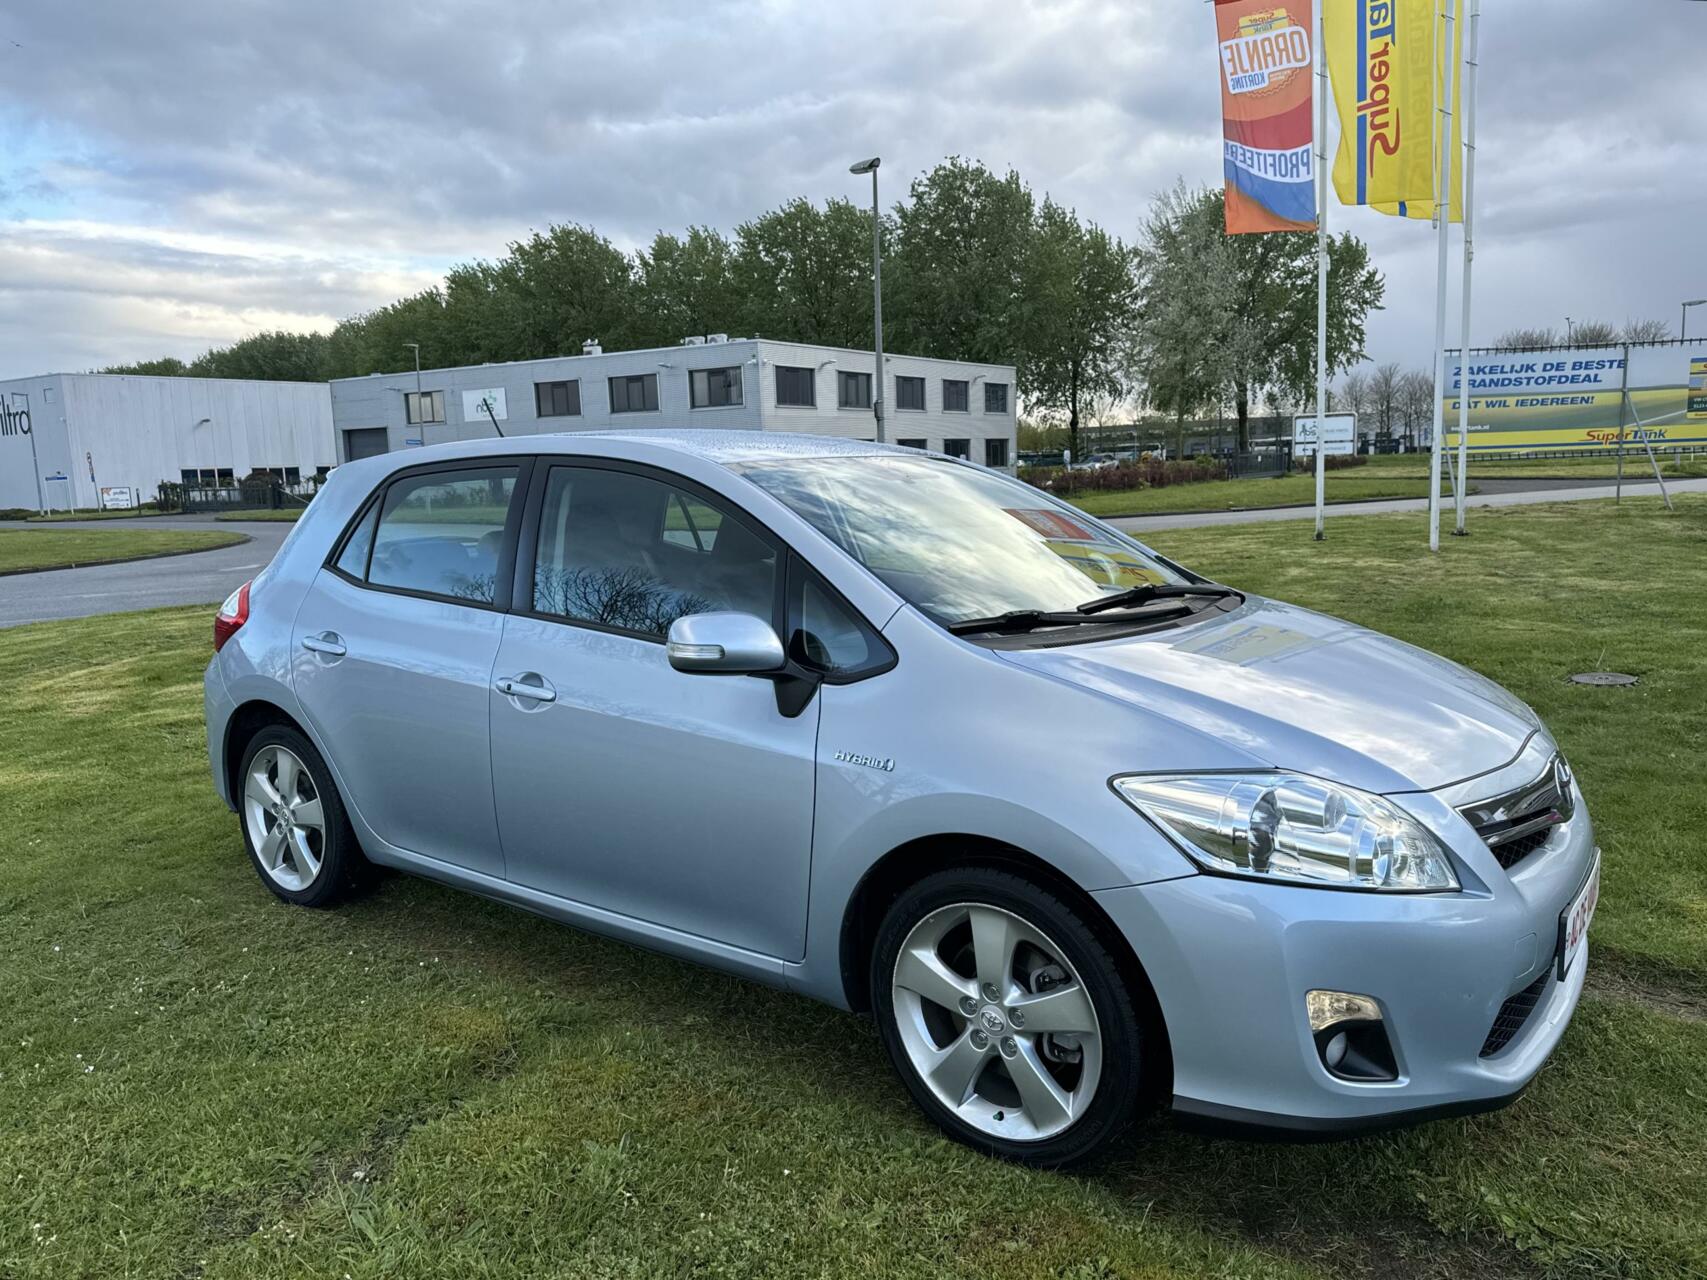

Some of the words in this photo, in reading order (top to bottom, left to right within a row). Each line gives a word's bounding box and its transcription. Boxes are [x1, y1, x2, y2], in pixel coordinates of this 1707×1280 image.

[1453, 363, 1537, 376] ZAKELIJK
[1542, 362, 1567, 373] DE
[1571, 359, 1627, 371] BESTE
[1453, 374, 1603, 389] BRANDSTOFDEAL
[1485, 400, 1510, 408] WIL
[1515, 396, 1595, 408] IEDEREEN!
[834, 750, 885, 770] HYBRID
